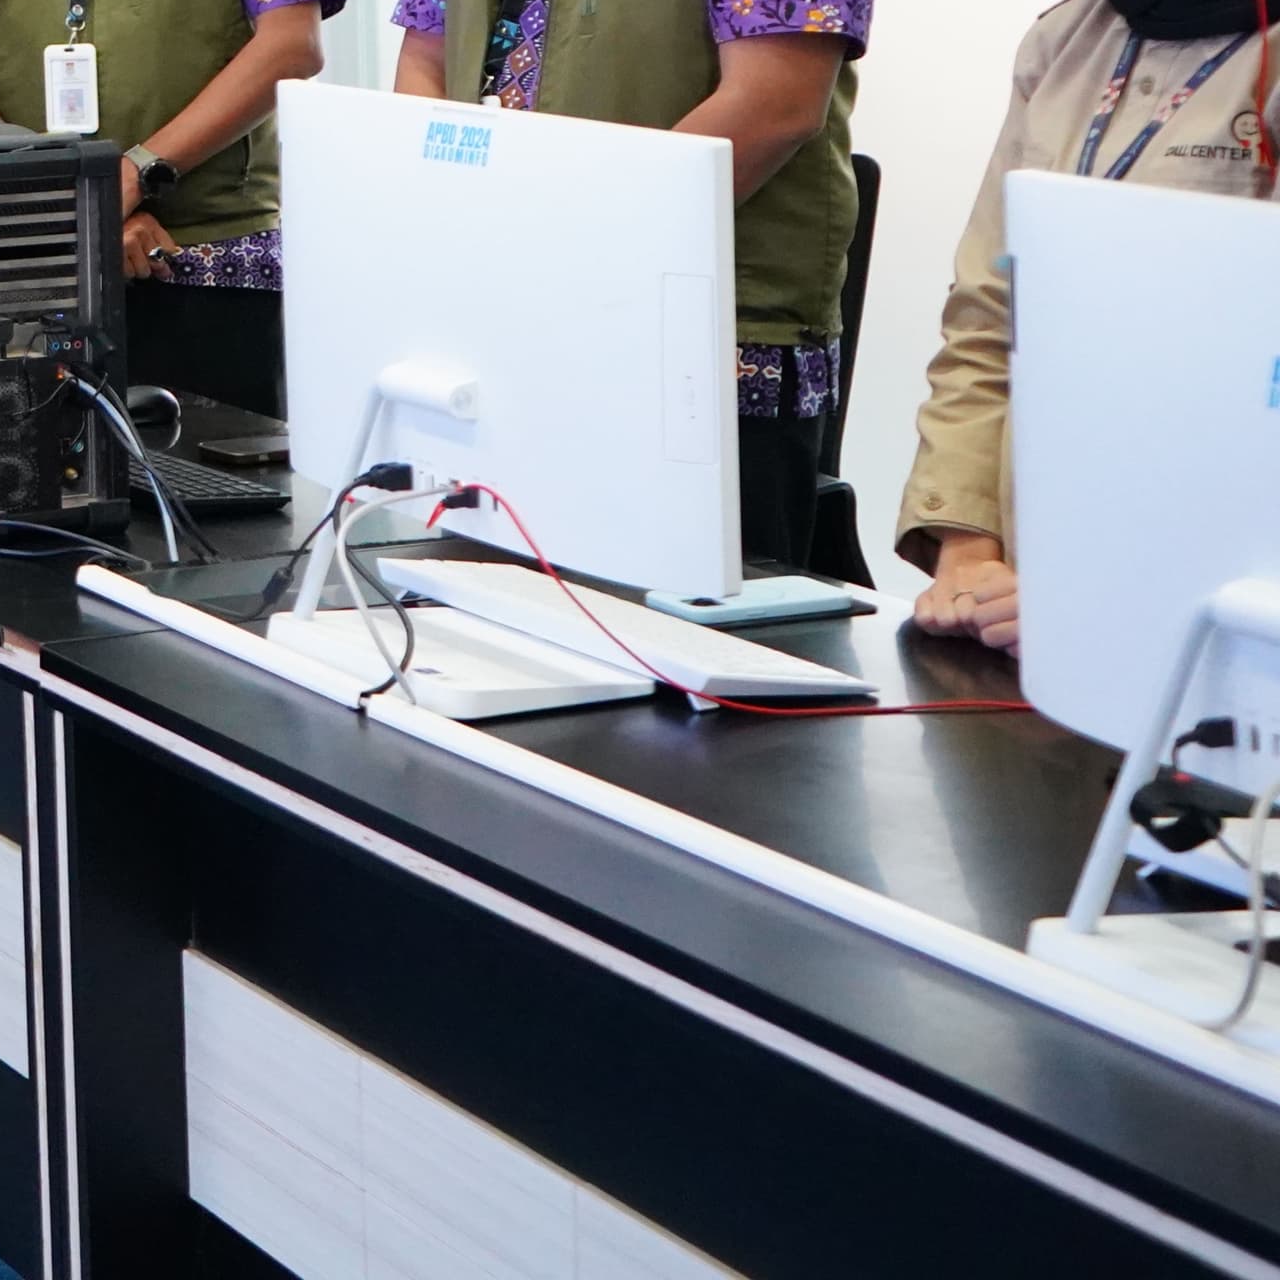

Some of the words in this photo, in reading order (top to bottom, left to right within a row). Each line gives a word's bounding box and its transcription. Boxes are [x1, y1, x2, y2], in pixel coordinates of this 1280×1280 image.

[426, 121, 457, 145] APBD
[459, 125, 492, 149] 2024
[423, 143, 489, 167] DISKOMINFO
[1190, 144, 1253, 161] CENTER
